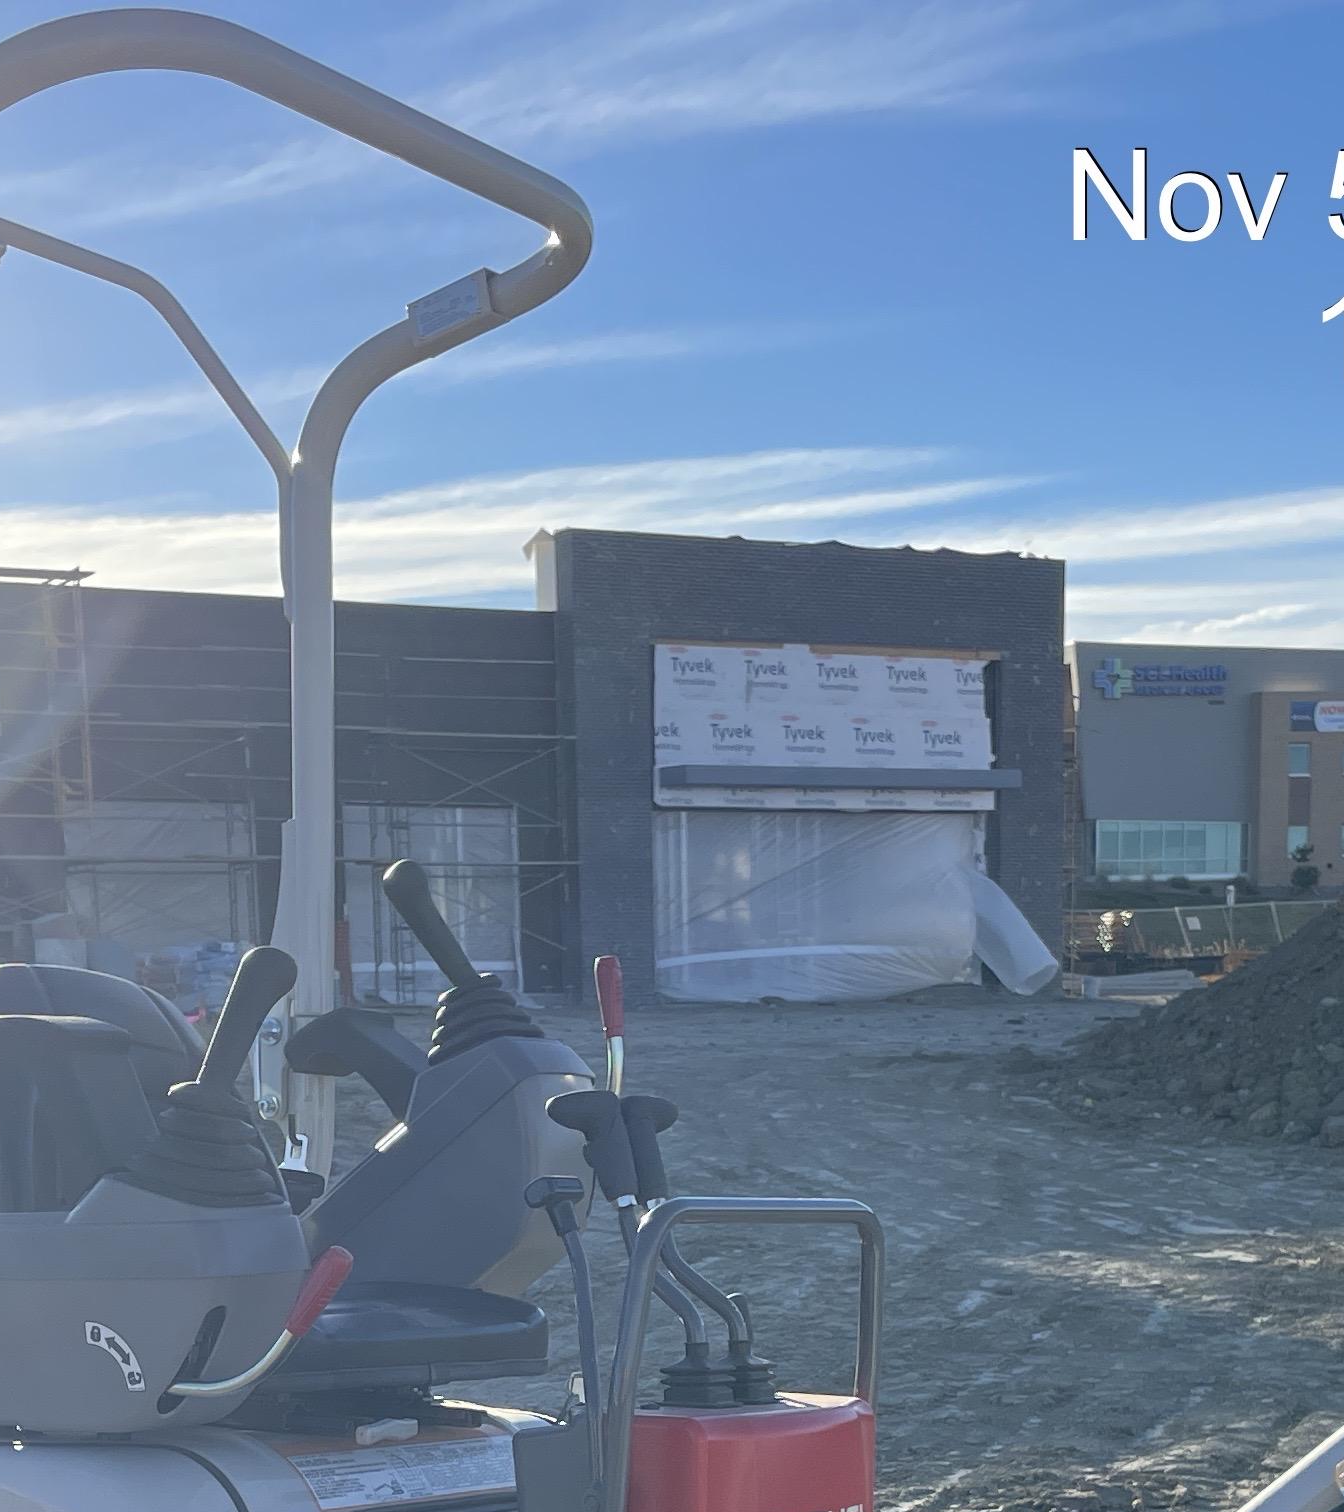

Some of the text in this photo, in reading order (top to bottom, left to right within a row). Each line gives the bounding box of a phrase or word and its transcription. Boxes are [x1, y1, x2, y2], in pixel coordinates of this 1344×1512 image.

[670, 657, 714, 674] Tyvek
[744, 659, 788, 677] Tyvek
[816, 663, 858, 681] Tyvek
[886, 666, 927, 683] Tyvek
[710, 723, 753, 741] Tyvek
[783, 725, 825, 743] Tyvek
[854, 728, 895, 745] Tyvek
[922, 730, 962, 748] Tyvek
